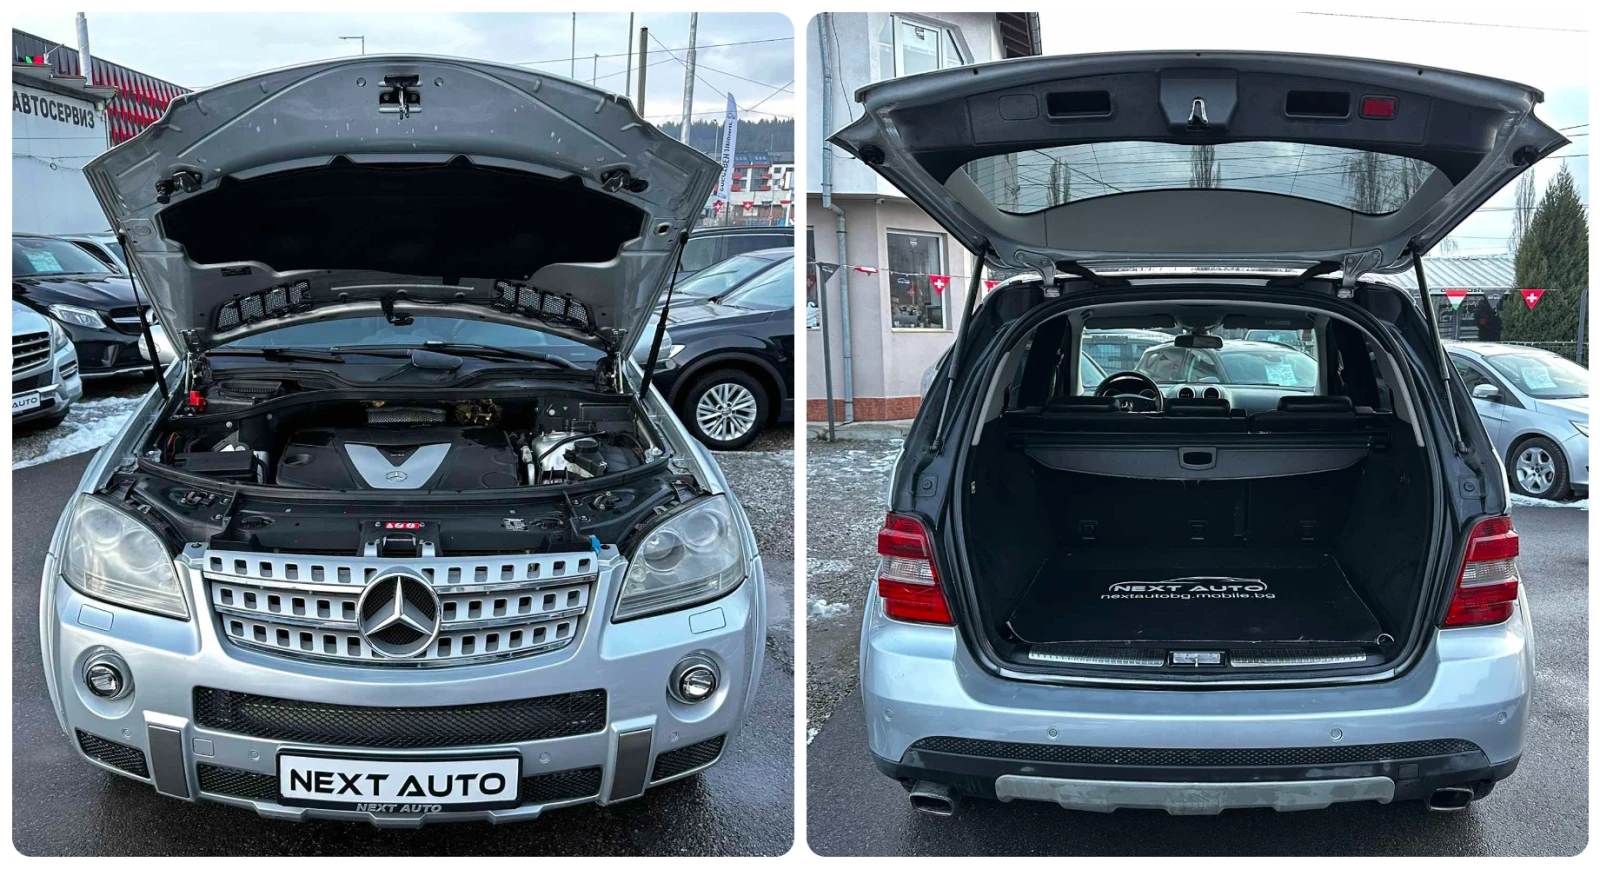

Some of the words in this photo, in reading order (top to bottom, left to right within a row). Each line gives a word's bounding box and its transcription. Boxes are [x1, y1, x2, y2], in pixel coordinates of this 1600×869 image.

[12, 91, 95, 129] АВТОСЕРВИЗ
[12, 397, 38, 408] AUTO
[1100, 592, 1276, 600] nextautobg.mobile.bg
[290, 768, 390, 796] NEXT
[396, 772, 506, 797] AUTO
[356, 803, 400, 813] NEXT
[400, 804, 442, 813] AUTO
